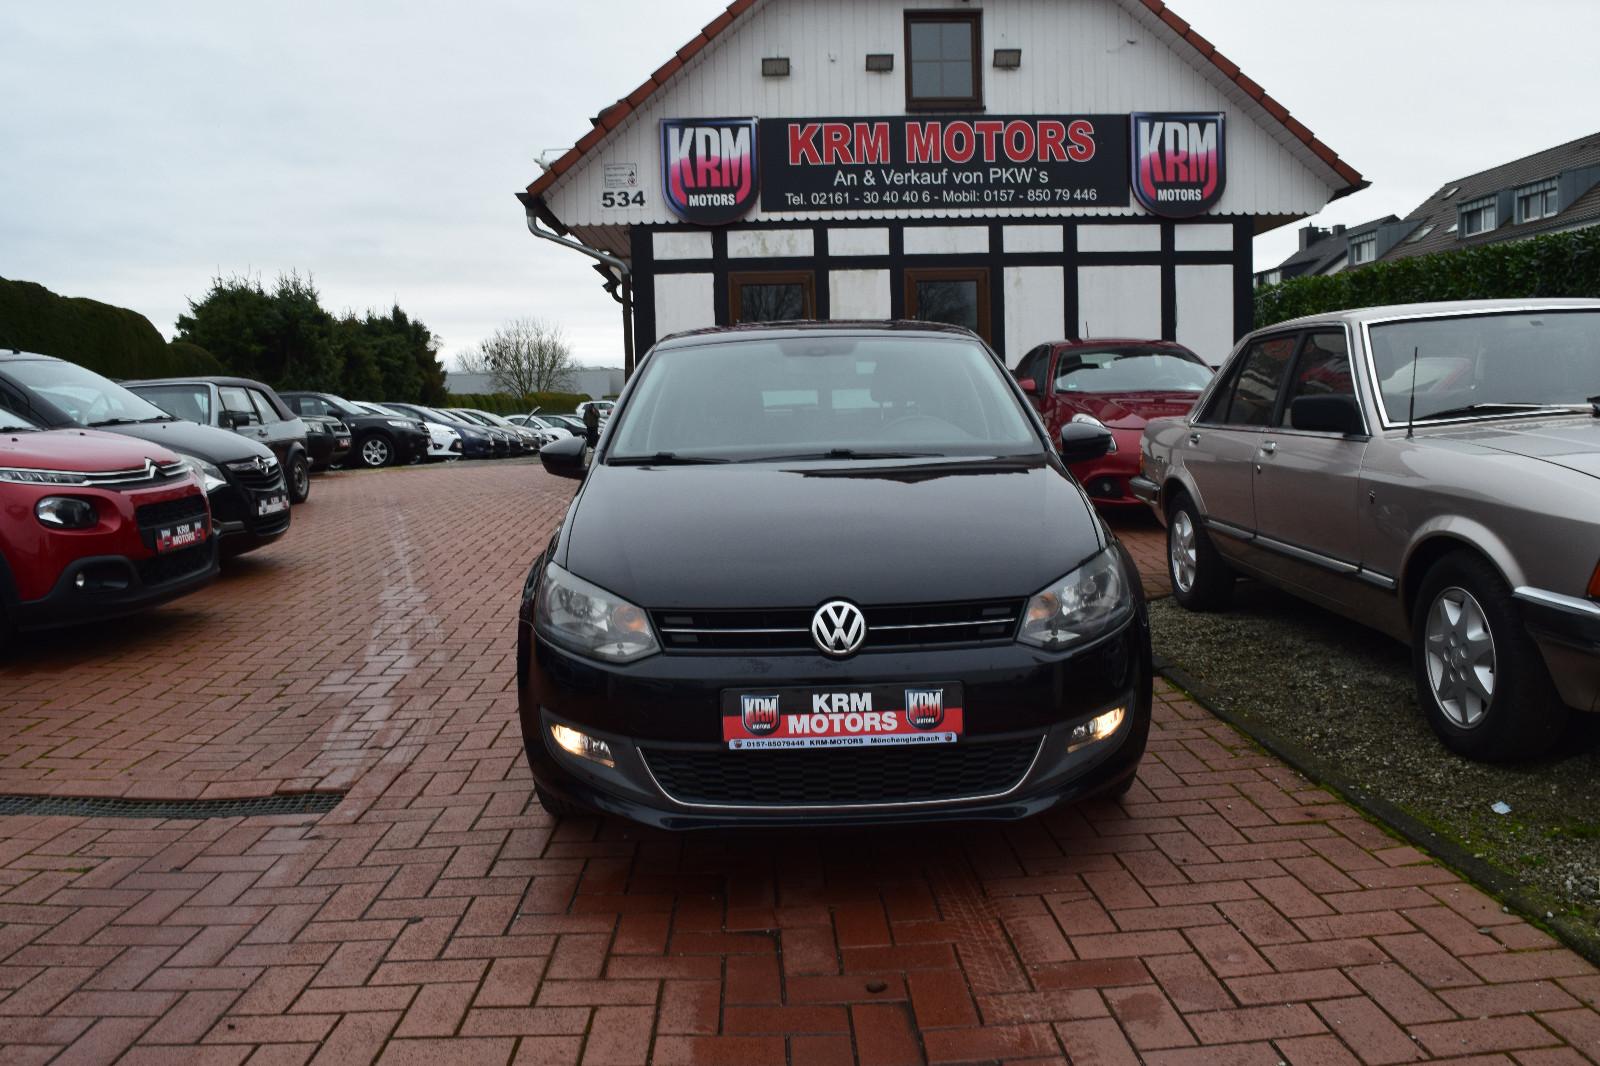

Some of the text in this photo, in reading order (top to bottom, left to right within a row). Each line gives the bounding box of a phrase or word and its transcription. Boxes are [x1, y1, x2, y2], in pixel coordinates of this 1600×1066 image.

[788, 120, 1096, 166] KRM MOTORS
[669, 126, 752, 205] KRM
[1139, 121, 1218, 200] KRM
[834, 170, 858, 186] An
[863, 169, 876, 186] &
[881, 168, 949, 186] Verkauf
[952, 171, 984, 184] von
[602, 190, 646, 208] 534
[688, 193, 736, 207] MOTORS
[785, 192, 807, 206] Tel.
[811, 192, 849, 205] 02161
[942, 190, 980, 202] Mobil:
[984, 189, 1015, 202] 0157
[1027, 189, 1051, 201] 850
[1054, 188, 1070, 201] 79
[1073, 188, 1098, 201] 446
[1157, 188, 1202, 202] MOTORS
[812, 692, 872, 713] KRM
[788, 711, 898, 734] MOTORS
